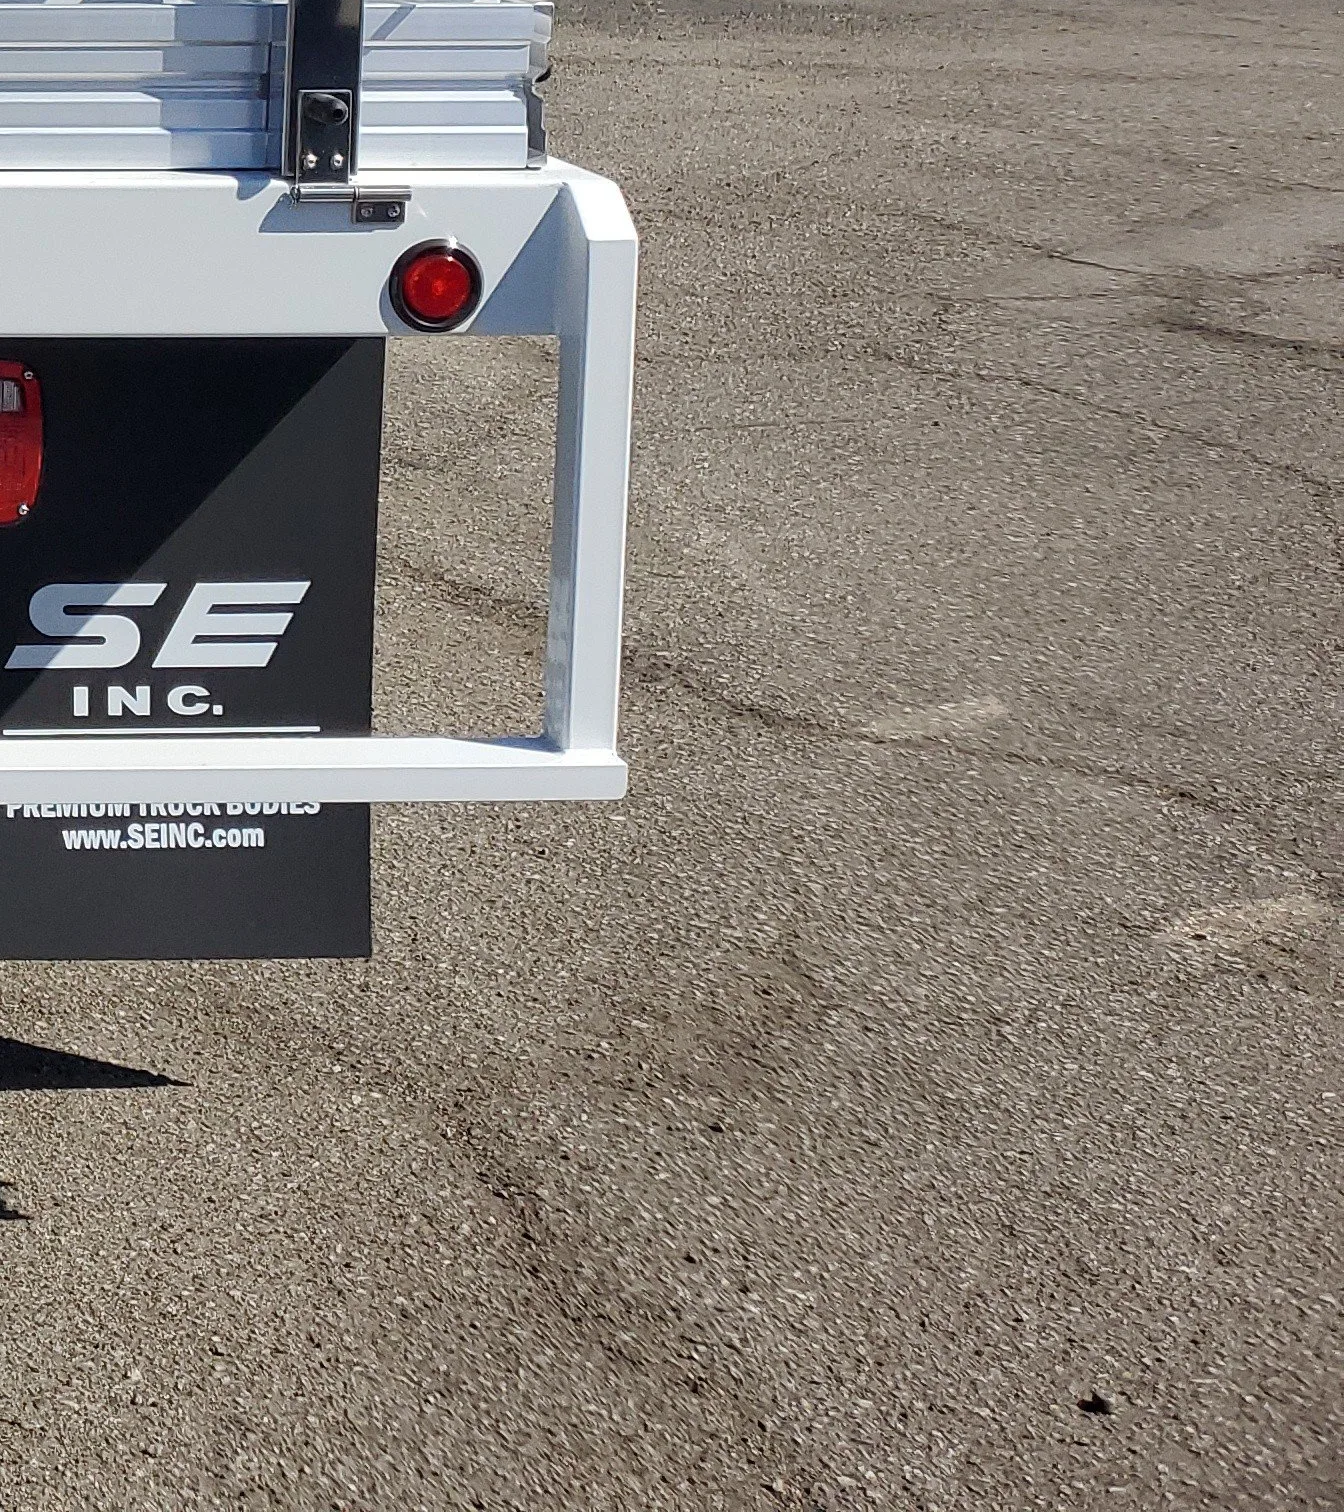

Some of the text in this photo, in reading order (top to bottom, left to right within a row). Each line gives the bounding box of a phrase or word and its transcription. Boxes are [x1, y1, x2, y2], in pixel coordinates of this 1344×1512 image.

[4, 581, 312, 669] SE
[72, 684, 223, 717] INC.
[62, 822, 265, 850] www.SEINC.com
